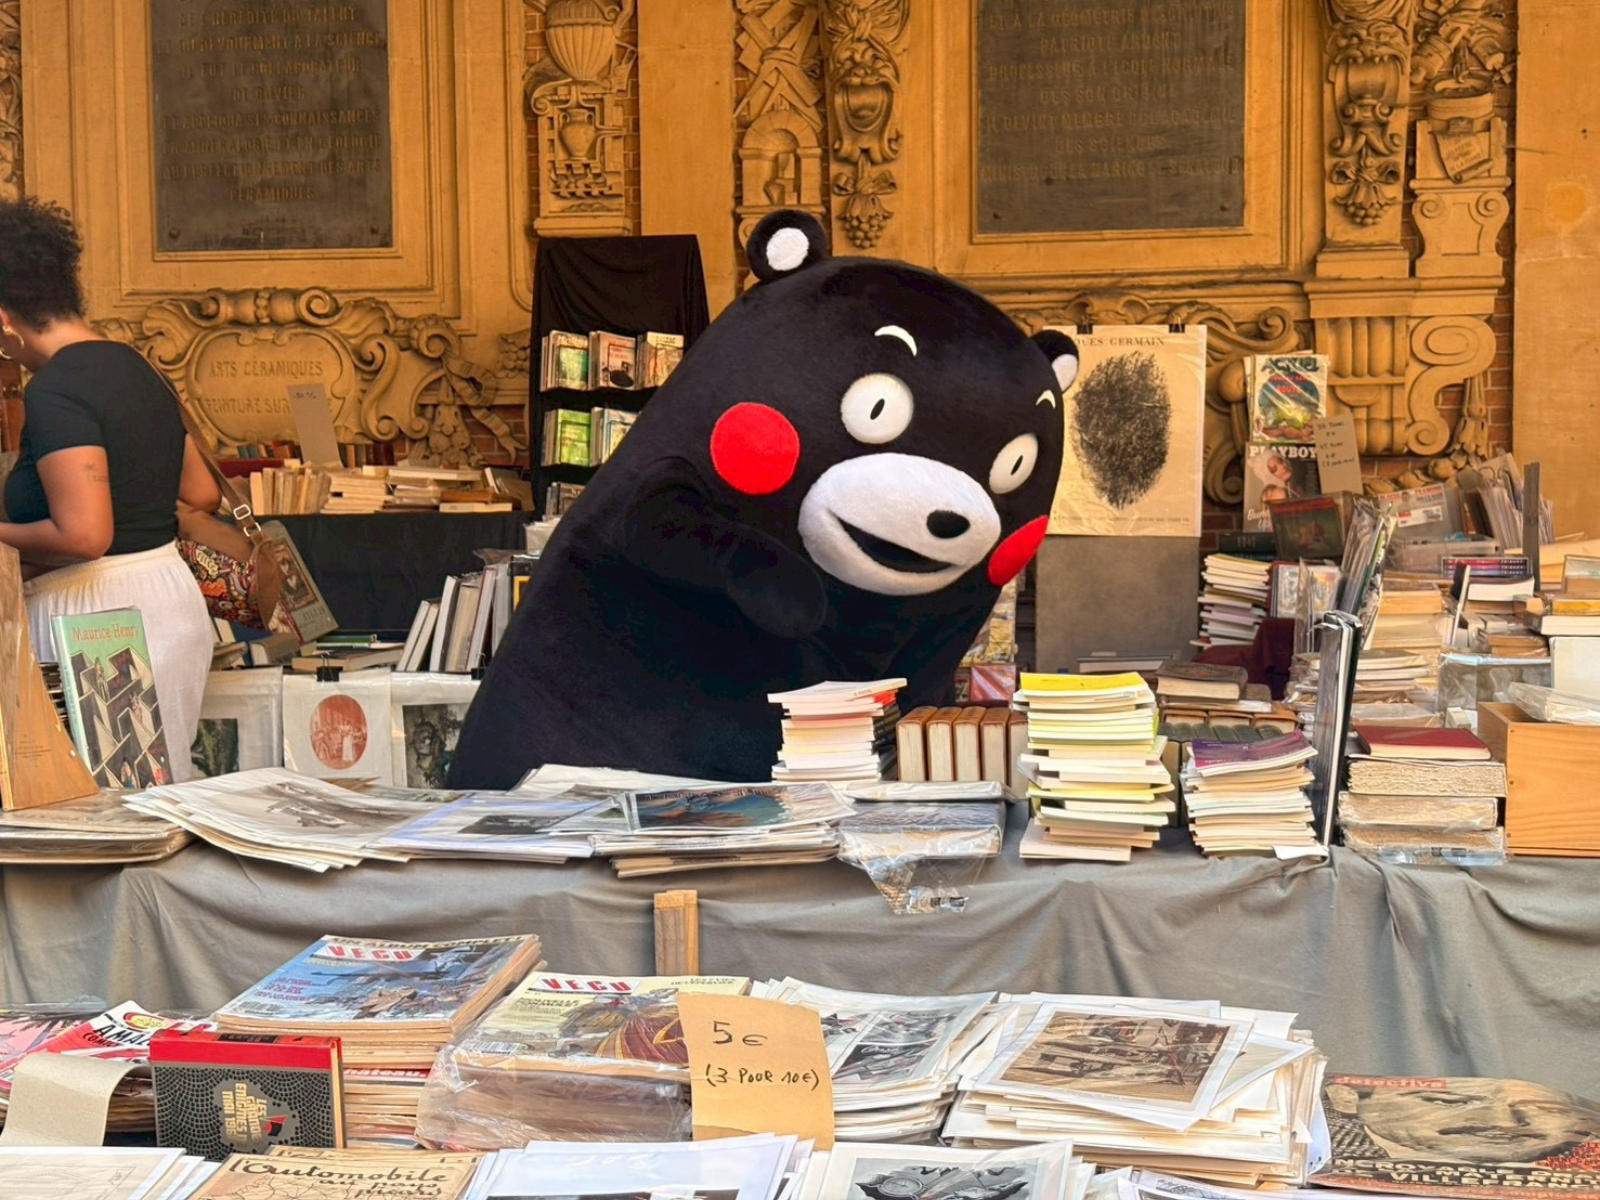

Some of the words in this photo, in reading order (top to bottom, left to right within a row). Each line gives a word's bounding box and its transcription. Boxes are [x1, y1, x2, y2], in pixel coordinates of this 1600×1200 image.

[1076, 337, 1104, 348] UES
[1110, 336, 1166, 347] GERMAIN
[209, 361, 238, 378] ARTS
[243, 355, 324, 379] CÉRAMIQUES
[205, 398, 262, 415] PEINTURE
[264, 398, 292, 416] SUR
[72, 626, 111, 644] Maurice
[113, 623, 140, 641] Henry
[739, 1067, 773, 1084] POUR
[1333, 1158, 1516, 1175] NCROYABLE
[1530, 1170, 1600, 1181] DRA
[1389, 1172, 1600, 1189] VILLEFRANC
